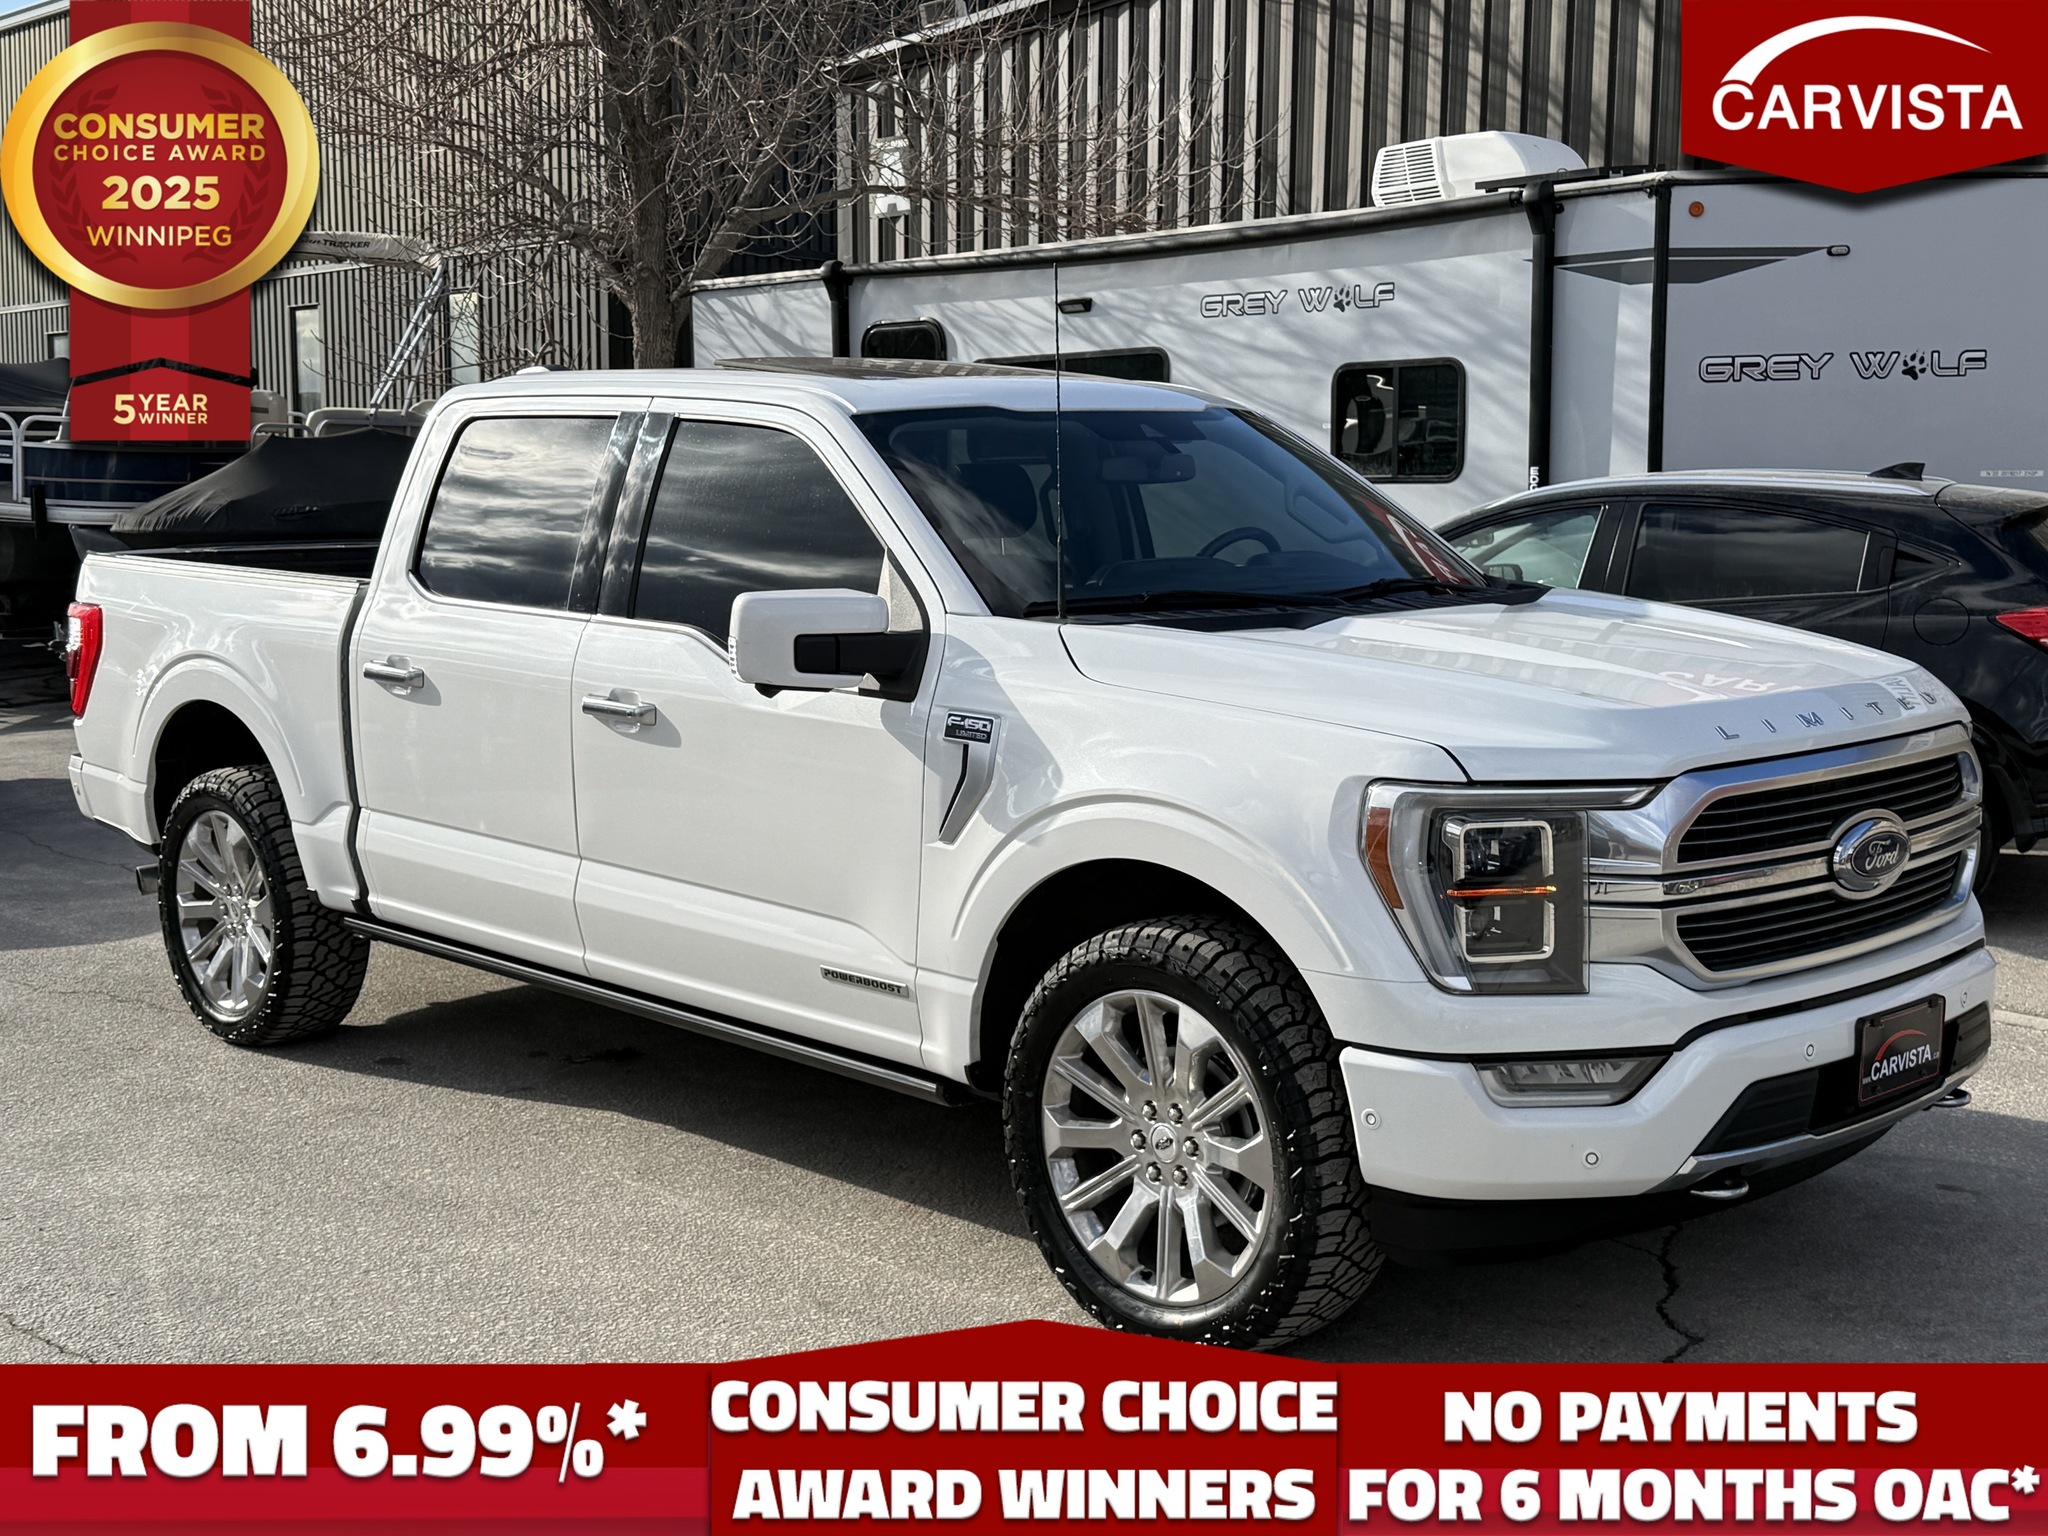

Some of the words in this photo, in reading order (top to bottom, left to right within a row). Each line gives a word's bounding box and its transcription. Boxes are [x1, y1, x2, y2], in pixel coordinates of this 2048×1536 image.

[323, 239, 371, 248] TRACKER
[1200, 289, 1287, 318] GREY
[1699, 352, 1834, 383] GREY
[947, 715, 991, 732] F-150
[1714, 691, 1937, 740] LIMITED
[955, 729, 987, 740] LIMITED
[1865, 839, 1899, 871] Ford
[823, 968, 902, 993] POWERBOOST
[1871, 1044, 1932, 1080] CARVISTA
